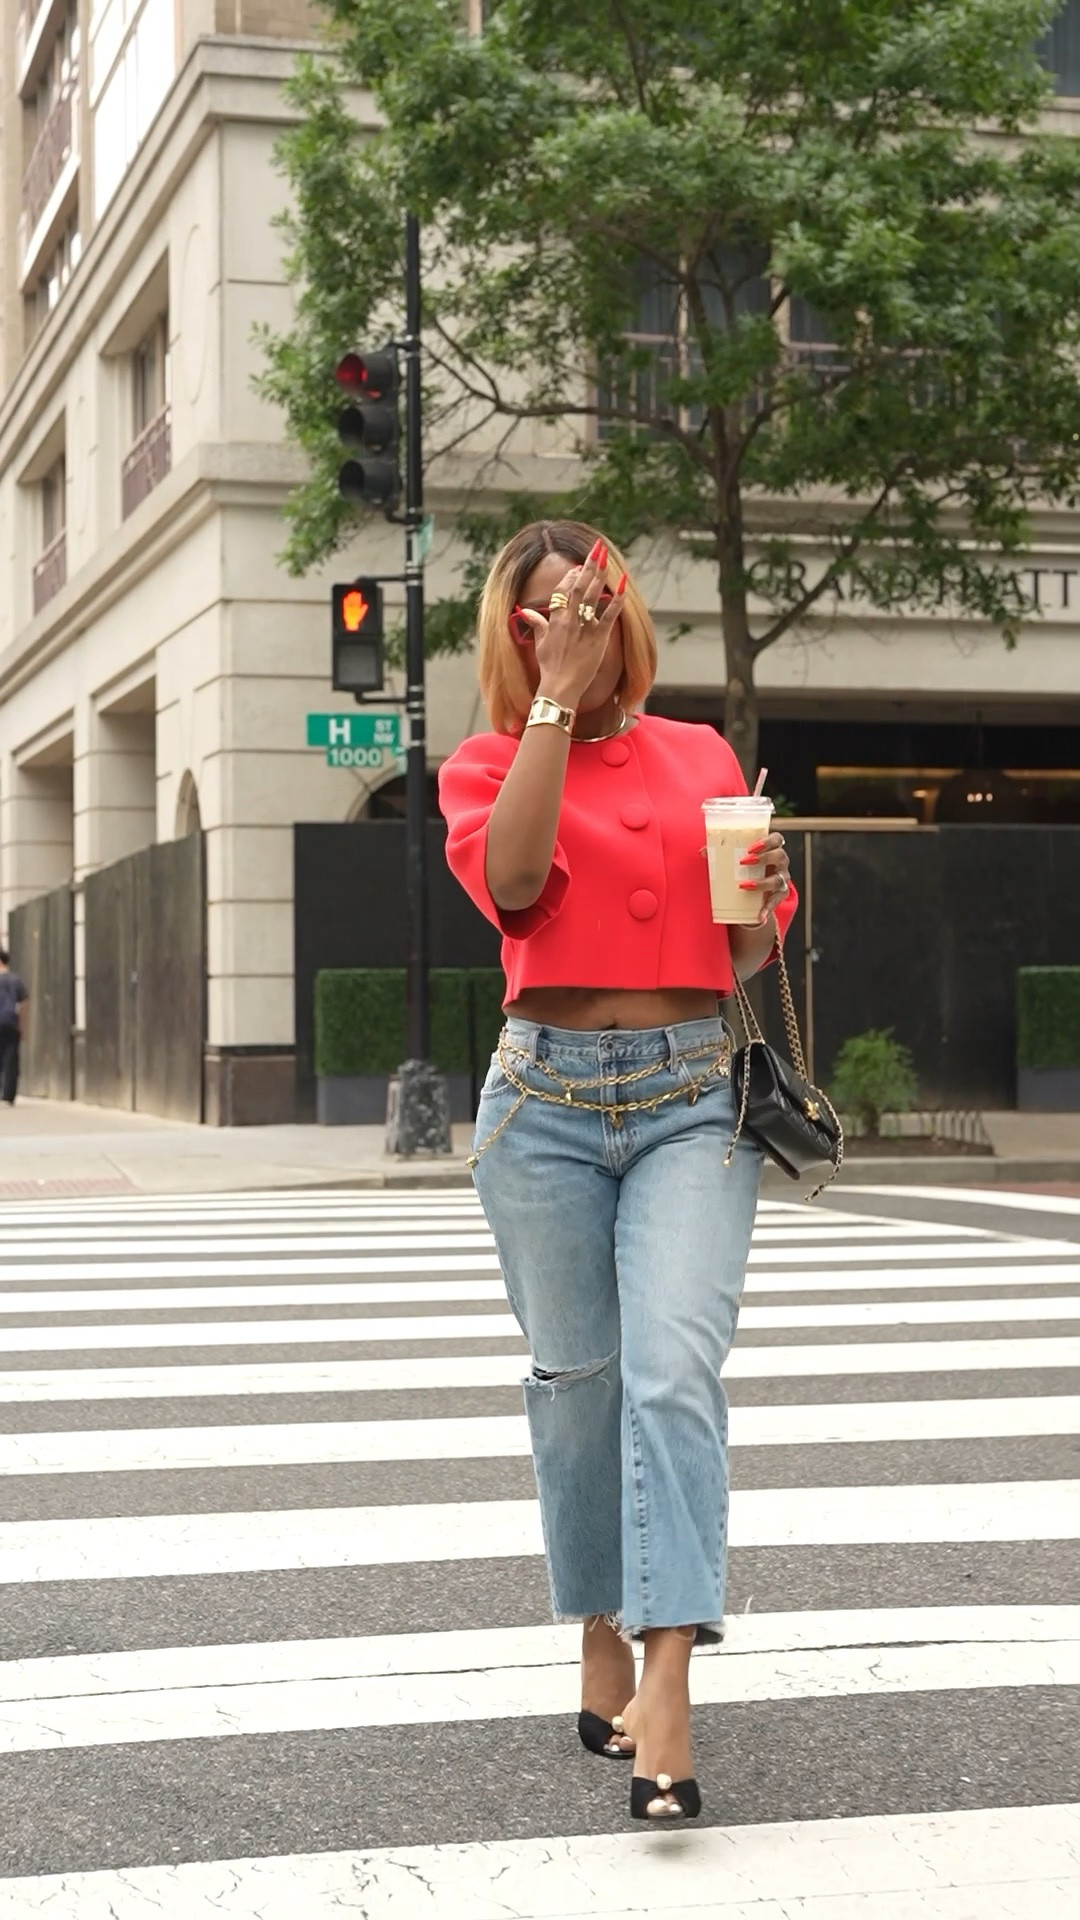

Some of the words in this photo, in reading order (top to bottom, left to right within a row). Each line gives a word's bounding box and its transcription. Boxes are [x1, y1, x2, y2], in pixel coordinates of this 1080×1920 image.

[329, 718, 351, 745] H
[375, 719, 393, 733] ST
[373, 733, 395, 745] NW
[330, 747, 381, 767] 1000
